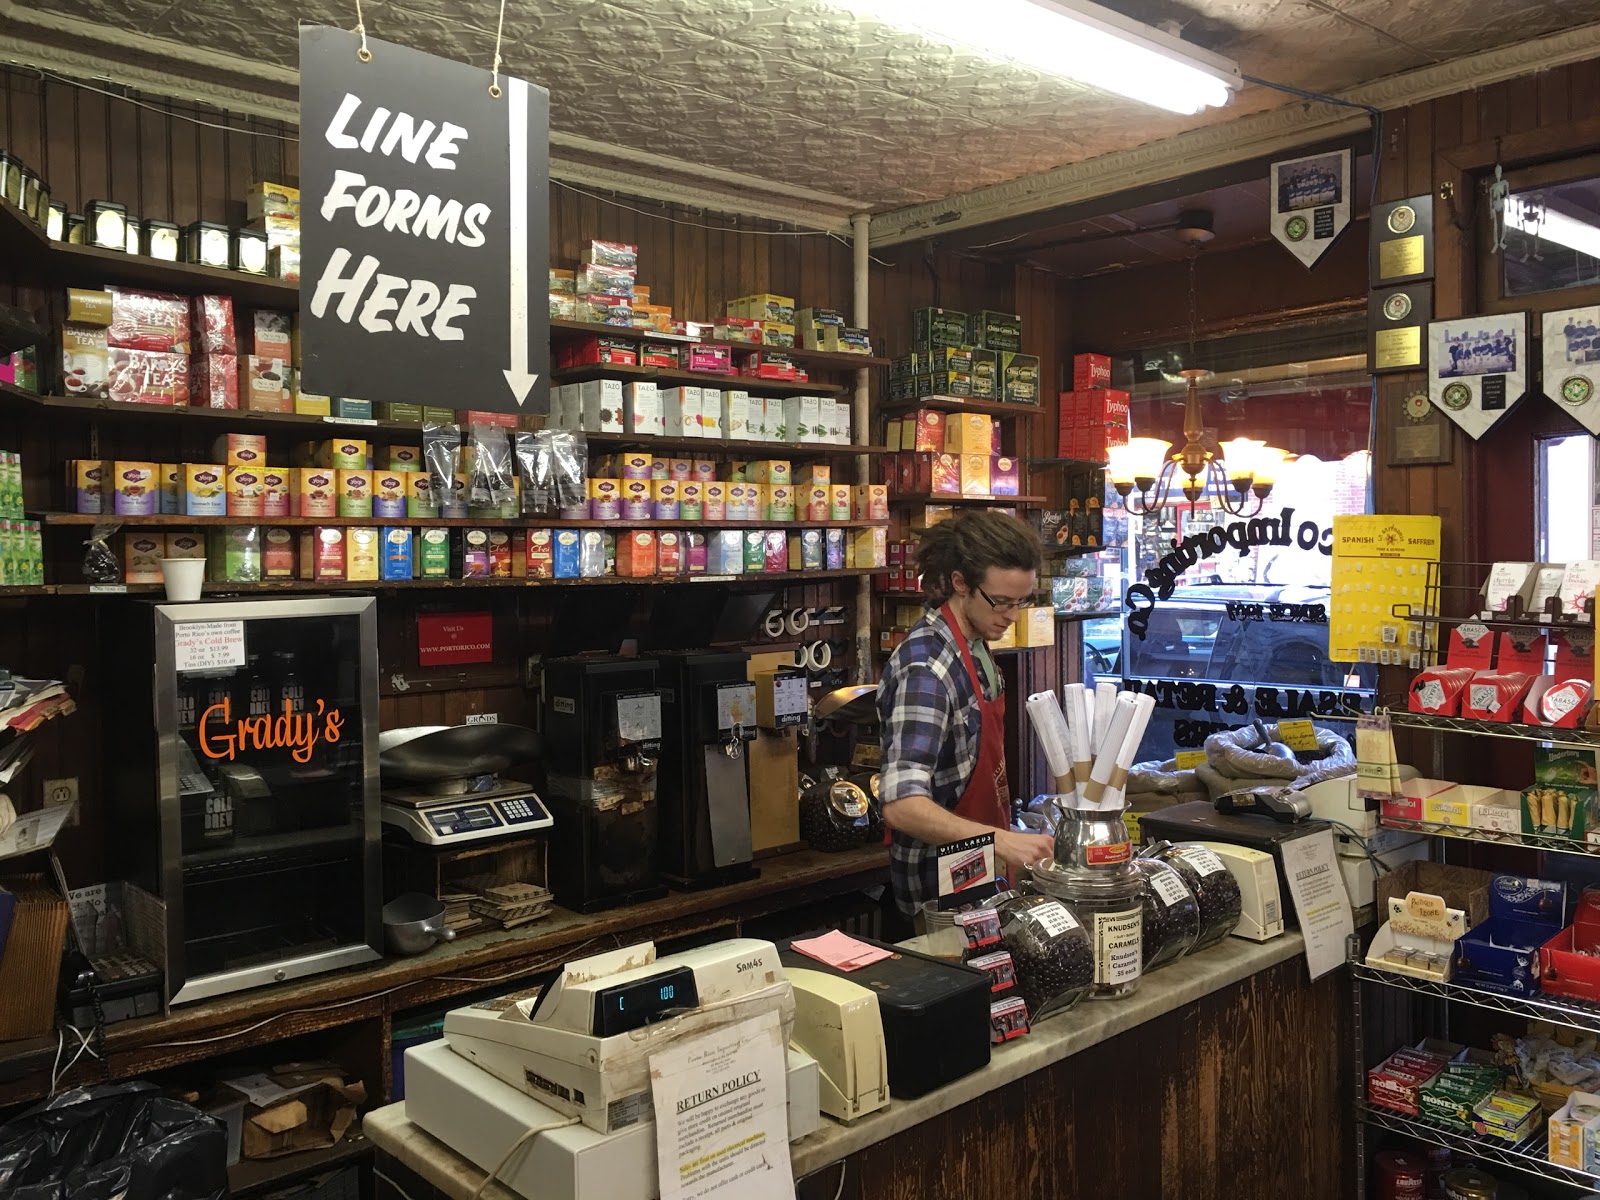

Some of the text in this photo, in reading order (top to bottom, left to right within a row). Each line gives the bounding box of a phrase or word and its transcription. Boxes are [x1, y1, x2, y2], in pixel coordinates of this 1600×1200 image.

[325, 93, 469, 170] LINE
[321, 170, 491, 247] FORMS
[309, 247, 477, 341] HERE
[144, 311, 174, 326] TEA
[987, 324, 1000, 333] China
[999, 325, 1013, 335] Green
[75, 335, 95, 346] TEA
[1006, 366, 1031, 378] China Green
[1089, 363, 1111, 378] Typhoo
[143, 371, 174, 388] TEA
[604, 382, 621, 391] TAZO
[638, 384, 655, 392] TAZO
[686, 388, 701, 397] TAZO
[705, 391, 720, 399] TAZO
[768, 400, 781, 408] TAZO
[803, 398, 818, 406] TAZO
[822, 399, 835, 407] TAZO
[1106, 399, 1129, 414] Typhoo
[198, 474, 213, 483] Yogi
[238, 475, 253, 484] Yogi
[265, 477, 279, 485] Yogi
[312, 477, 326, 485] Yogi
[349, 479, 363, 487] Yogi
[1342, 536, 1374, 544] SPANISH
[1407, 537, 1436, 546] SAFFRON
[531, 544, 550, 554] Chai
[179, 623, 222, 631] Brooklyn-Made
[442, 625, 455, 633] Visit
[1459, 626, 1488, 634] TABASCO
[1510, 630, 1538, 638] TABASCO
[204, 636, 242, 645] Cold Brew
[420, 643, 491, 654] WWW.PORTORICO.COM
[197, 660, 215, 668] (DIY)
[1471, 686, 1495, 708] TABASCO
[467, 714, 497, 724] GRINDS
[781, 714, 801, 723] ditting
[199, 696, 345, 764] Grady's
[84, 888, 102, 897] are
[1107, 920, 1140, 933] KNUDSEN'S
[1108, 937, 1140, 950] CARAMELS
[1110, 949, 1138, 961] Knudsen's
[735, 957, 764, 974] SAM4S
[1112, 958, 1138, 969] Caramels
[1124, 966, 1137, 975] each
[676, 1069, 761, 1113] RETURN POLICY
[686, 1114, 695, 1123] will
[701, 1108, 714, 1118] happy
[720, 1097, 740, 1109] exchange
[748, 1089, 761, 1099] goods
[1422, 1094, 1465, 1112] HONEES
[678, 1127, 688, 1136] give
[688, 1121, 699, 1130] store
[699, 1116, 711, 1126] credit
[718, 1108, 733, 1117] unused
[733, 1100, 751, 1111] returned
[707, 1117, 727, 1129] Returned
[727, 1106, 753, 1119] merchandise
[753, 1102, 764, 1110] must
[679, 1139, 695, 1150] include
[720, 1123, 732, 1133] parts
[736, 1113, 753, 1125] original
[680, 1163, 692, 1172] Sales
[699, 1155, 710, 1164] final
[716, 1148, 727, 1157] used
[726, 1140, 746, 1152] electrical
[680, 1168, 701, 1181] Problems
[701, 1162, 712, 1171] with
[718, 1155, 730, 1163] units
[729, 1148, 744, 1158] should
[749, 1138, 766, 1149] directed
[681, 1177, 699, 1189] towards
[698, 1173, 706, 1181] the
[710, 1184, 718, 1192] not
[717, 1179, 729, 1188] offer
[728, 1174, 739, 1183] cash
[744, 1166, 756, 1176] credit
[1396, 1178, 1423, 1187] LAVAZZA
